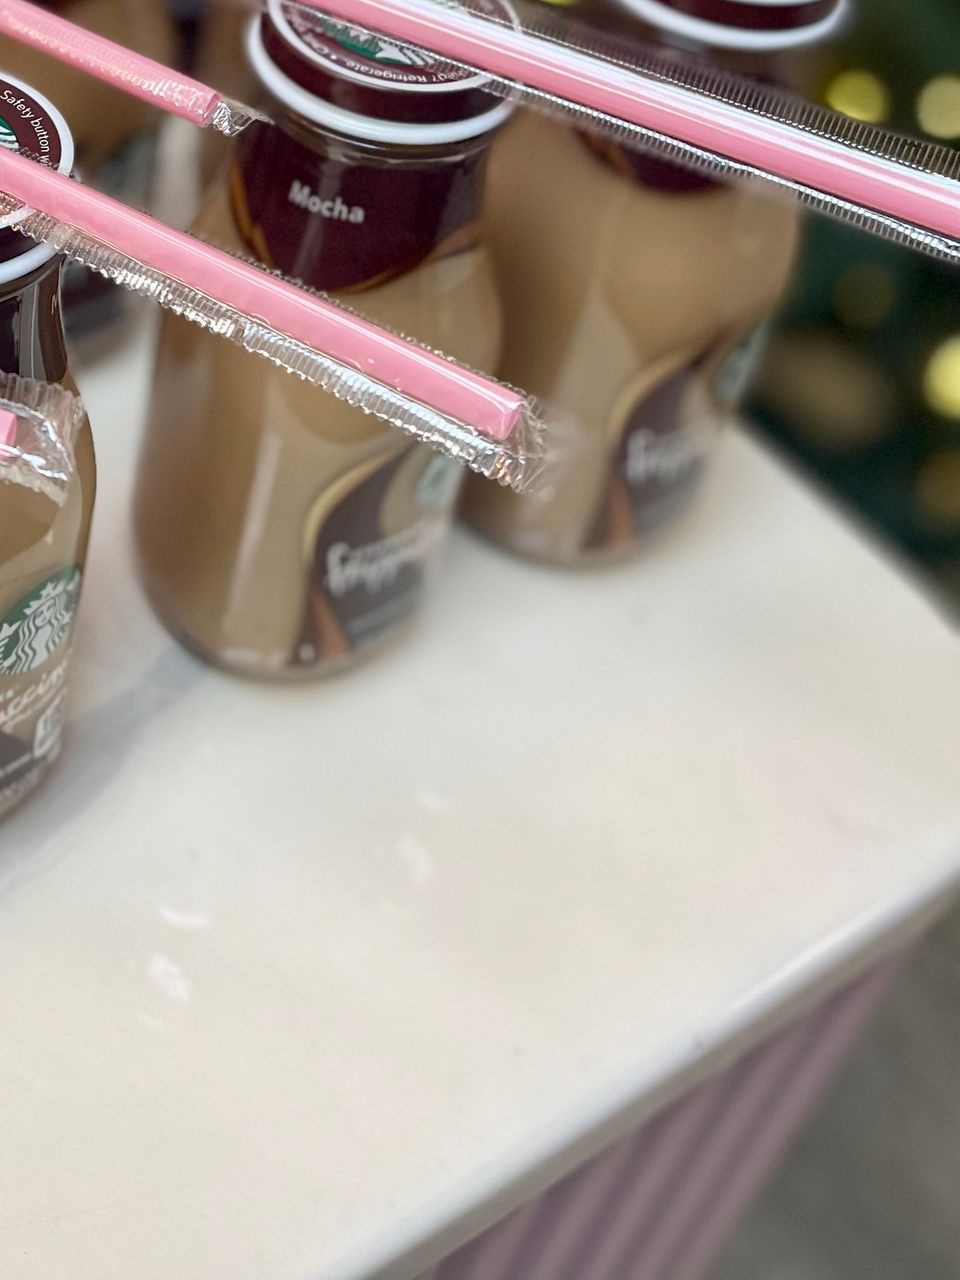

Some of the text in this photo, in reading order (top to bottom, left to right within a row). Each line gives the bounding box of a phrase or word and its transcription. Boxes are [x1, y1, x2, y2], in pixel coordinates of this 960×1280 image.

[0, 89, 35, 119] Safety
[30, 118, 51, 153] button
[288, 179, 365, 224] Mocha
